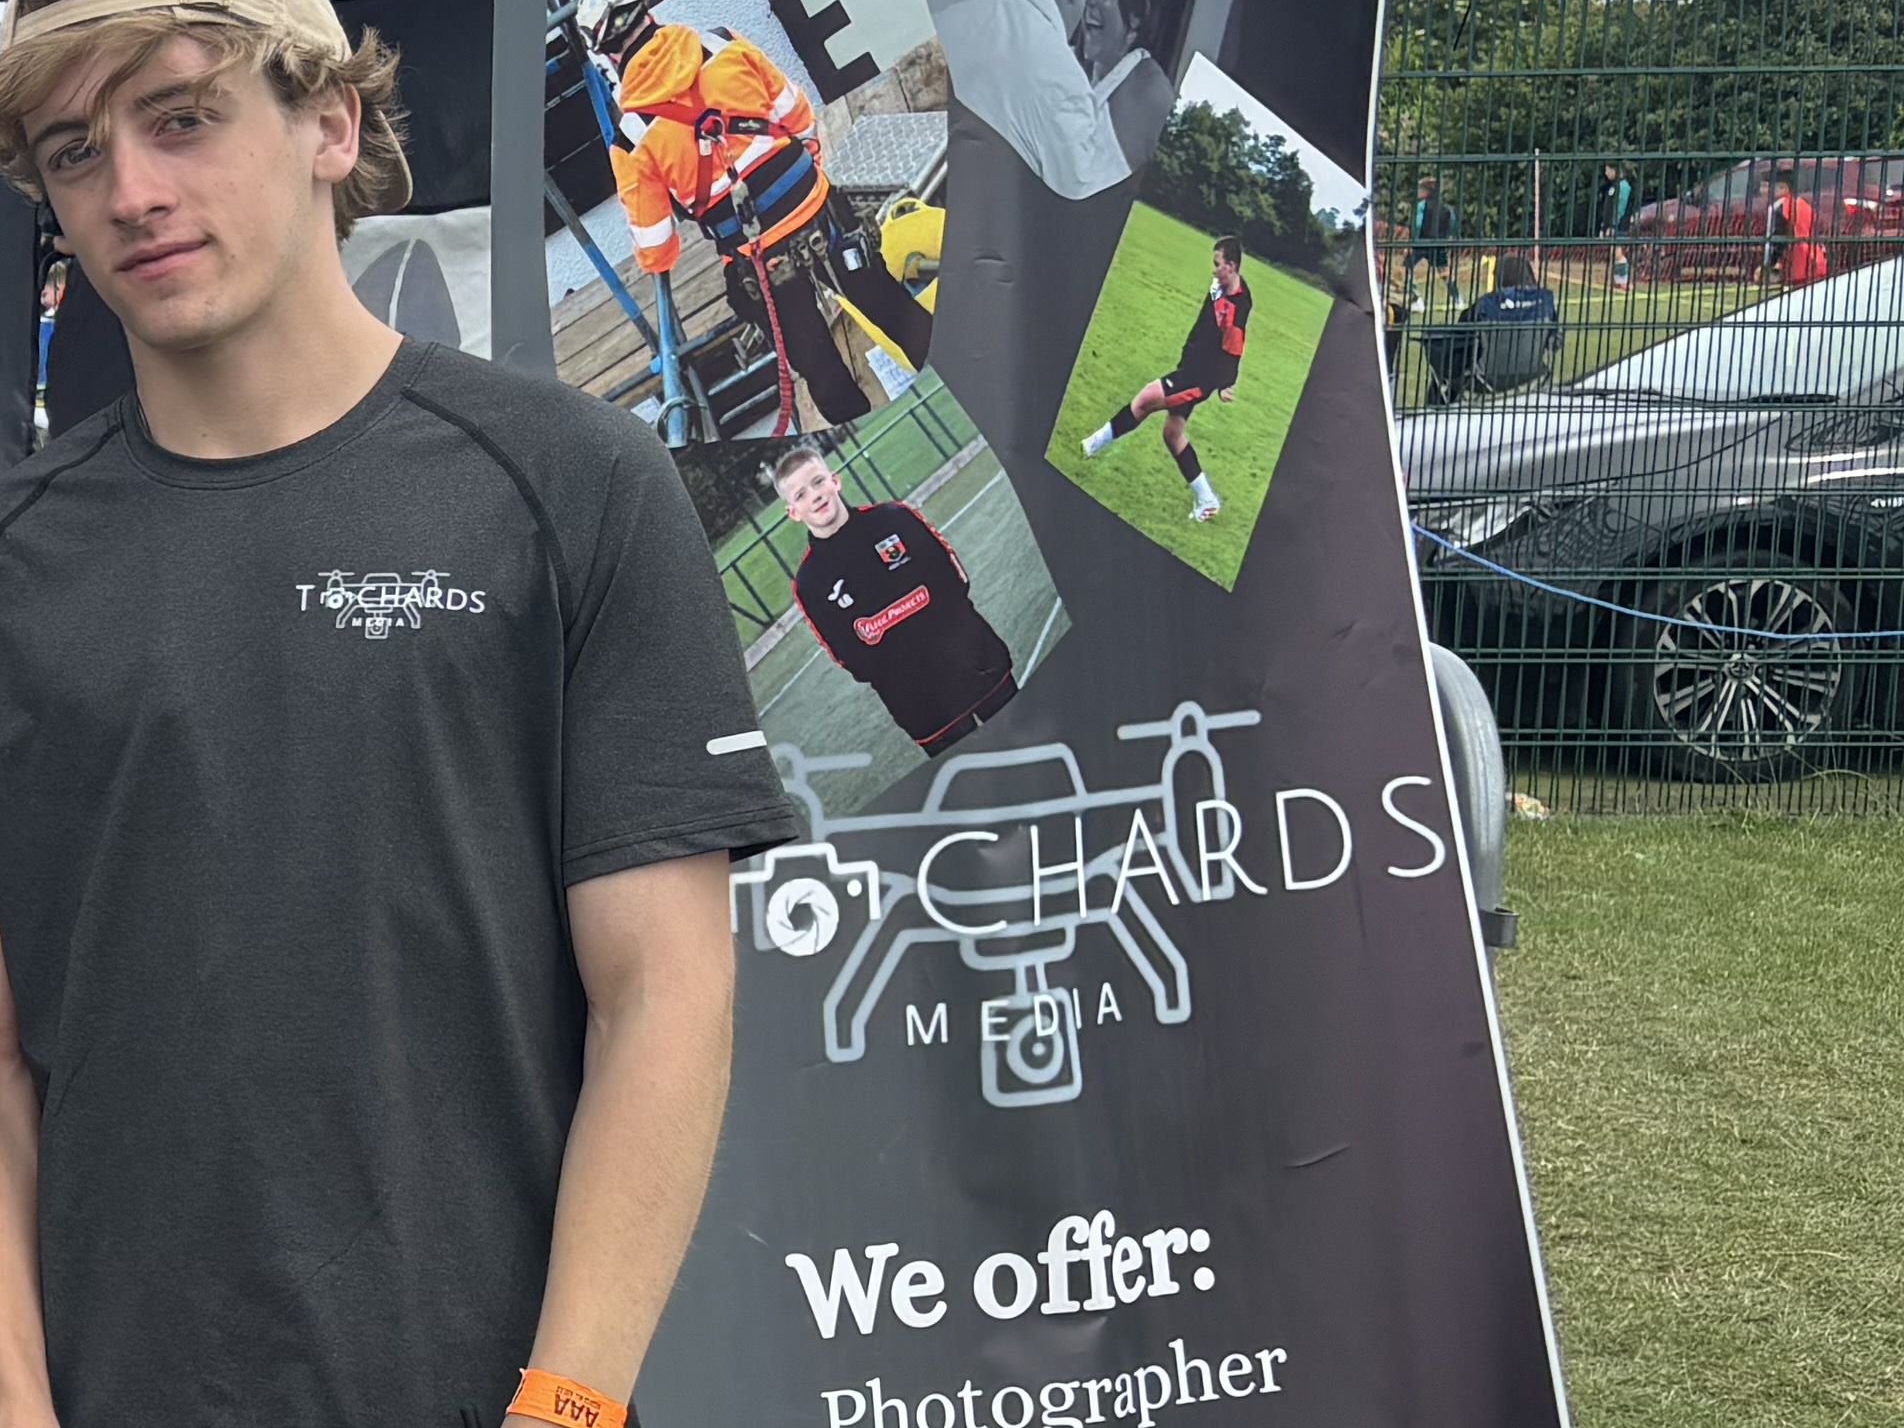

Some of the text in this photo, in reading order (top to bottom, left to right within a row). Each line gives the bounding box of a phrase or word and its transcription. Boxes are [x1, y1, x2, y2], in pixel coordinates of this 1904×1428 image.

[918, 775, 1447, 933] CHARDS
[906, 981, 1123, 1045] MEDIA
[785, 1209, 1213, 1339] We offer:
